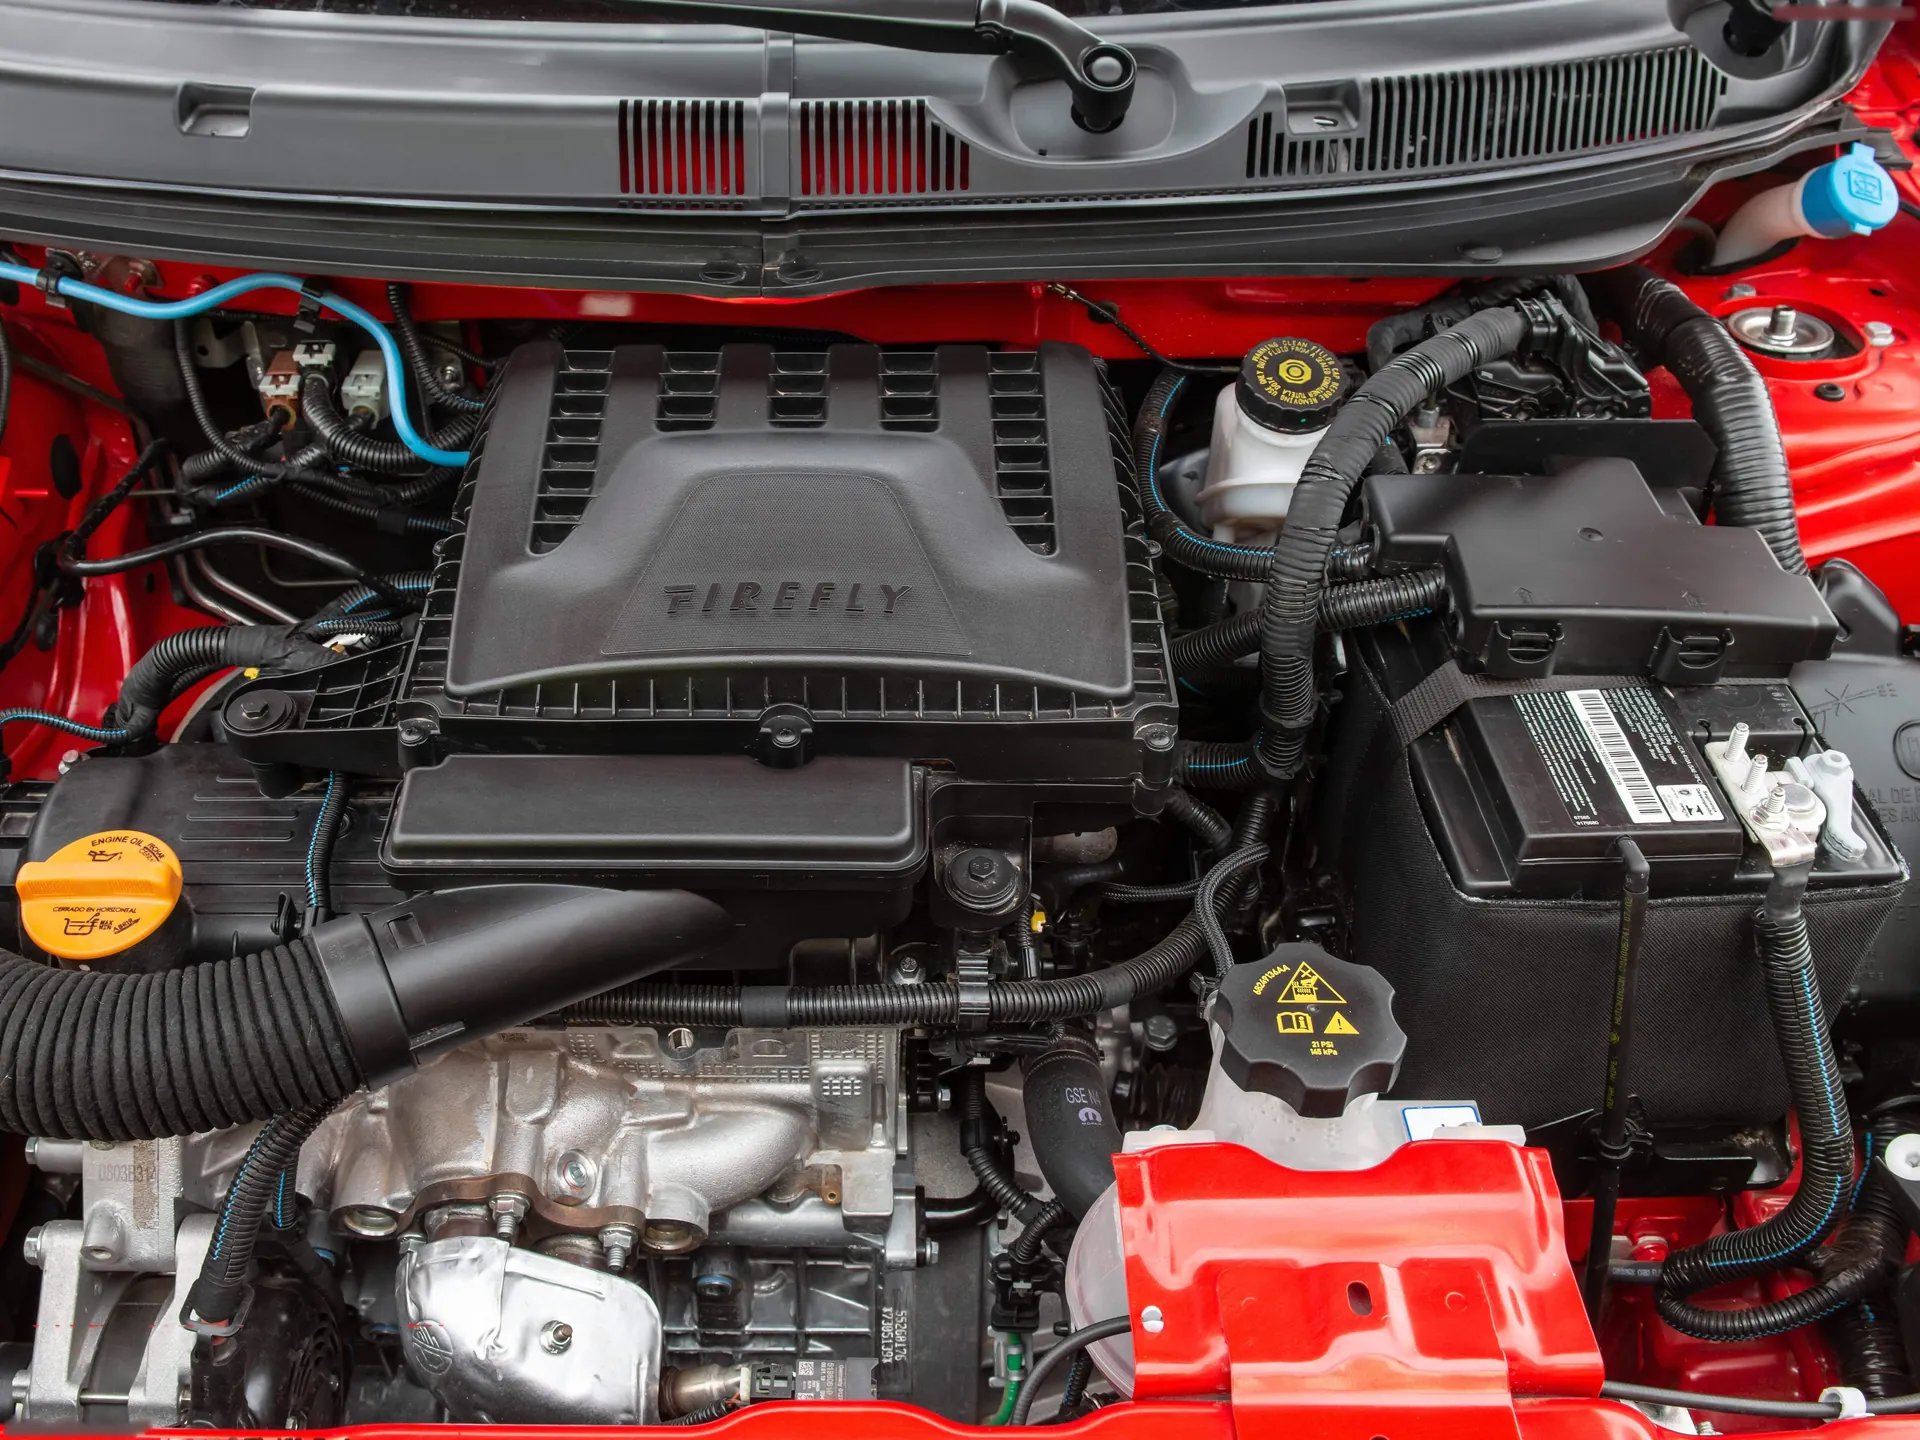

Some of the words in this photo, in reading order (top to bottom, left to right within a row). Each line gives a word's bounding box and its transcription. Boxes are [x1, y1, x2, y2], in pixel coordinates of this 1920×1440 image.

[1252, 342, 1278, 362] WARNING
[1268, 346, 1288, 356] FLUID
[1291, 346, 1310, 354] FROM
[1310, 346, 1336, 366] FILLER
[1332, 368, 1340, 380] CAP
[1264, 386, 1278, 396] USE
[1282, 389, 1307, 398] TUTELA
[1318, 381, 1340, 401] BEFORE
[1280, 394, 1318, 405] REMOVING
[663, 581, 912, 614] FIREFLY
[91, 836, 129, 847] ENGINE
[130, 837, 144, 848] OIL
[147, 842, 165, 859] FECHAR
[113, 918, 133, 932] ABRIR
[1066, 1088, 1088, 1104] GSE
[895, 1310, 908, 1362] 55268176
